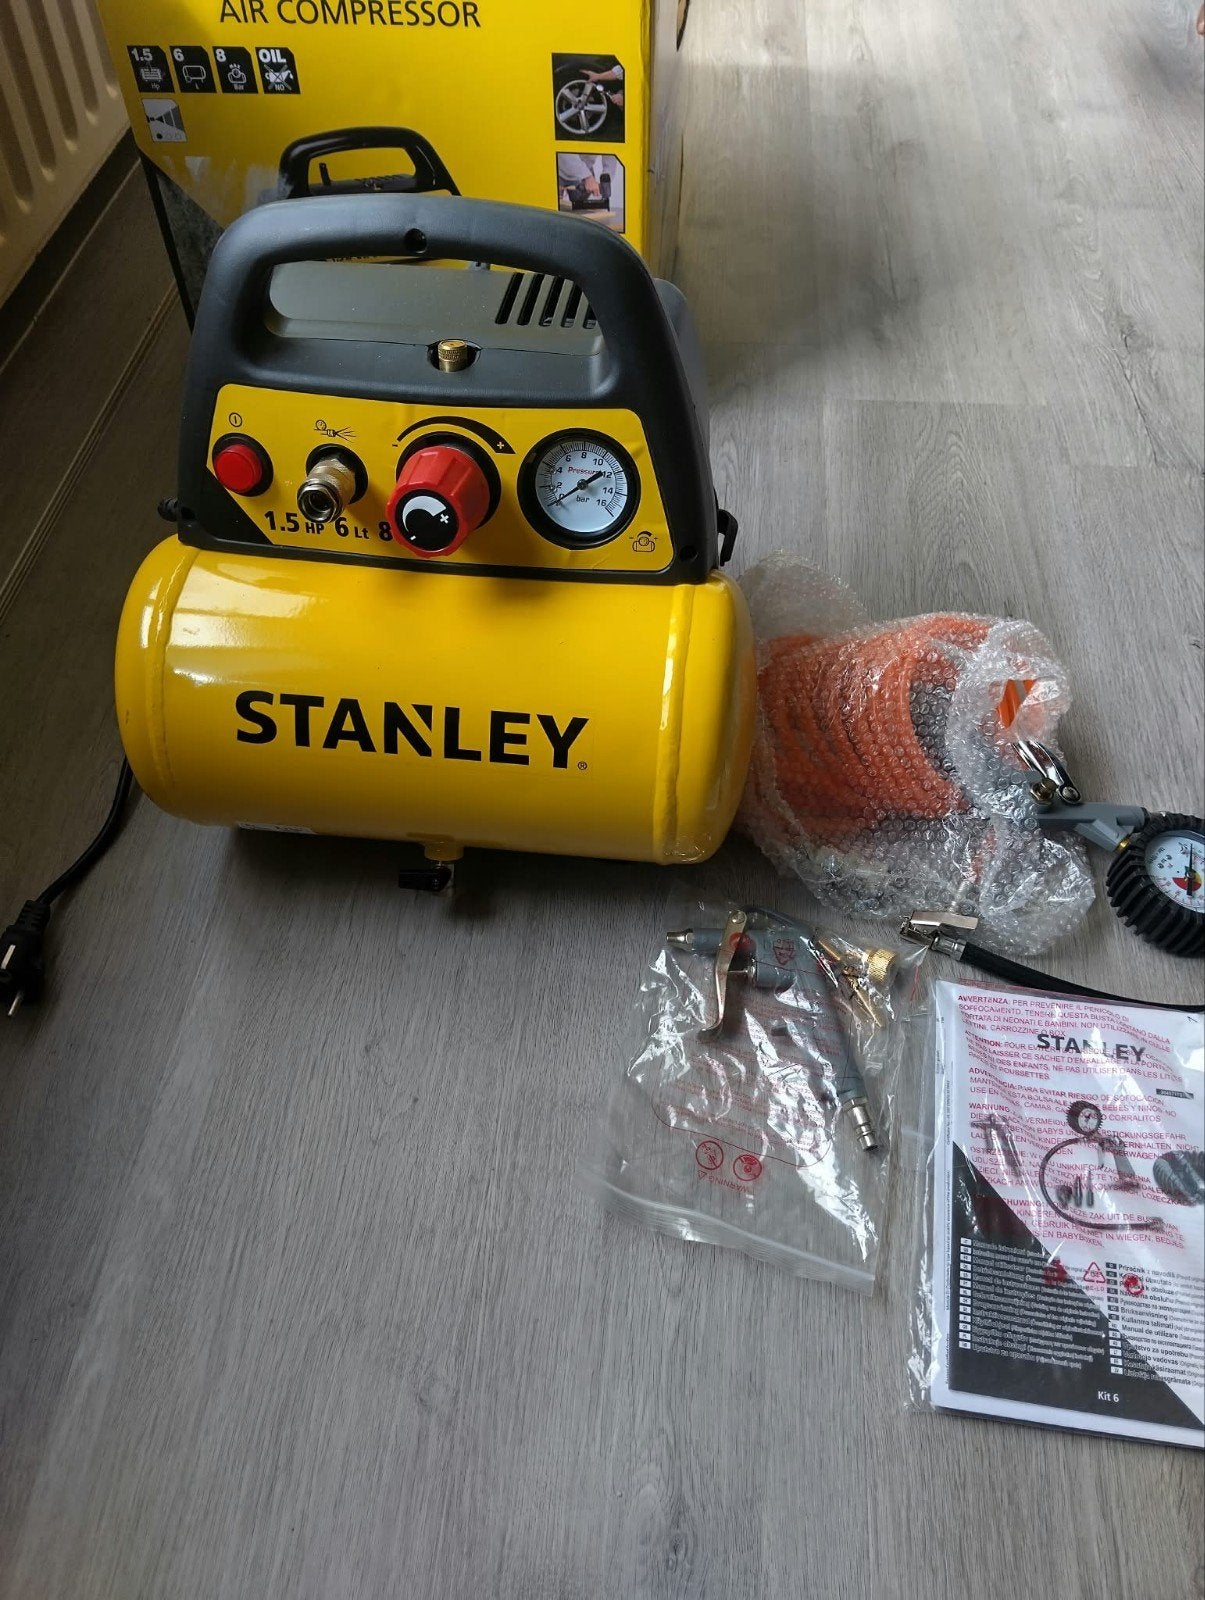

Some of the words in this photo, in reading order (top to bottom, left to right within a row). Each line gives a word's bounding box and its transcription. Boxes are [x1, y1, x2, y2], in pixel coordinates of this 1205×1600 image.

[220, 0, 269, 24] AIR
[276, 0, 481, 28] COMPRESSOR
[131, 48, 153, 62] 1.5
[173, 48, 185, 62] 6
[215, 49, 227, 63] 8
[258, 49, 287, 63] OIL
[593, 458, 604, 466] 10
[556, 466, 563, 474] 4
[602, 471, 613, 479] 12
[556, 481, 563, 489] 2
[602, 487, 614, 495] 14
[575, 495, 590, 503] bar
[596, 499, 607, 507] 16
[264, 511, 300, 533] 1.5
[305, 521, 325, 535] HP
[335, 516, 350, 538] 6
[354, 526, 370, 540] Lt
[378, 521, 394, 542] 8
[235, 690, 590, 770] STANLEY
[1012, 999, 1029, 1007] PER
[1030, 1000, 1075, 1010] PREVENIRE
[990, 1024, 1039, 1035] CARROZZINE
[1058, 1012, 1090, 1020] QUESTA
[1146, 1032, 1171, 1045] DALLA
[1080, 1021, 1099, 1029] NON
[1004, 1041, 1026, 1050] POUR
[1033, 1053, 1066, 1063] SACHET
[1065, 1066, 1080, 1074] PAS
[1067, 1090, 1099, 1101] RIESGO
[969, 1086, 987, 1094] USE
[1108, 1114, 1161, 1122] CORRALITOS
[1089, 1211, 1105, 1220] ZAK
[1107, 1212, 1121, 1221] UIT
[1123, 1213, 1136, 1221] DE
[1042, 1230, 1054, 1238] EN
[1121, 1324, 1144, 1333] Manual
[1097, 1390, 1112, 1402] Kit
[1113, 1393, 1120, 1403] 6
